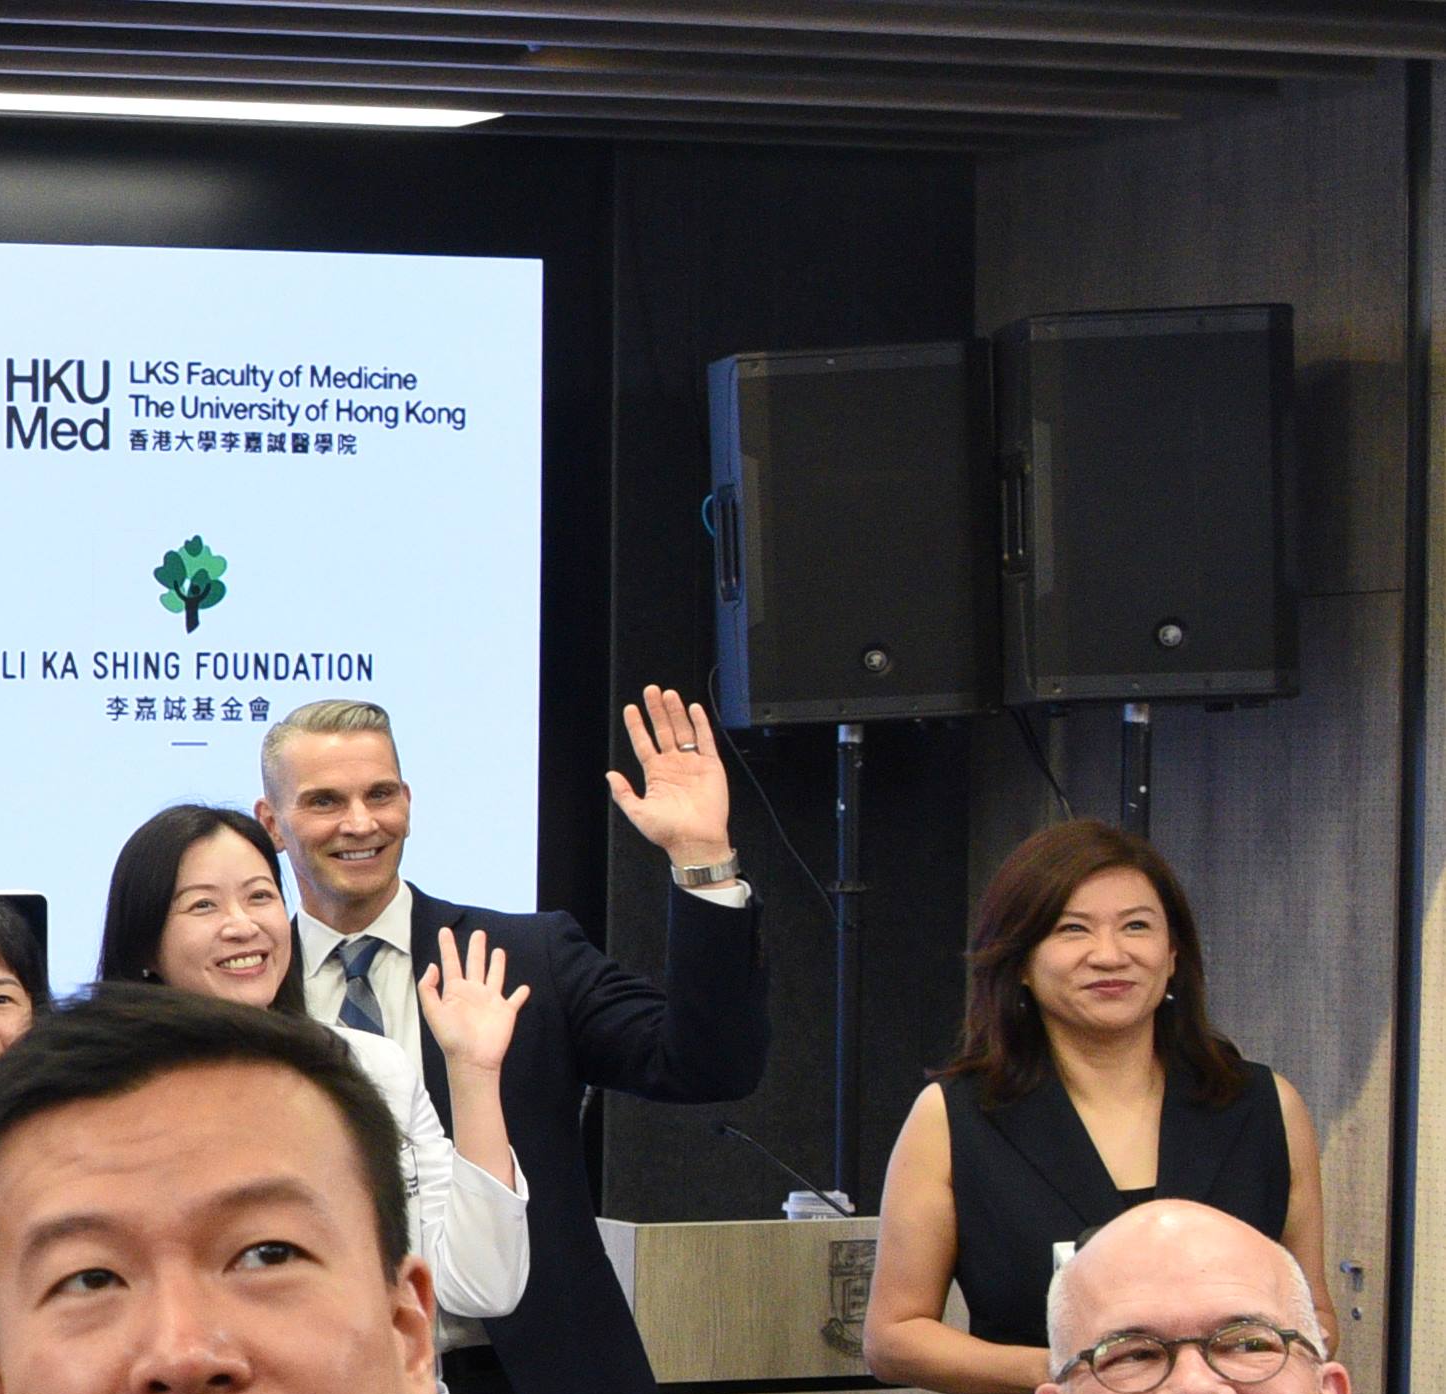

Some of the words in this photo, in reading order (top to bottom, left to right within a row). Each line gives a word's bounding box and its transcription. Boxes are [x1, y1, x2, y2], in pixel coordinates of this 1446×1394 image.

[7, 358, 110, 404] HKU
[129, 361, 180, 385] LKS
[187, 361, 274, 393] Faculty
[279, 365, 303, 388] of
[310, 365, 418, 391] Medicine
[7, 405, 110, 451] Med
[129, 394, 175, 418] The
[181, 395, 300, 427] University
[305, 399, 329, 421] of
[336, 399, 399, 429] Hong
[405, 401, 466, 431] Kong
[129, 429, 358, 455] 香港大學李嘉誠醫學院
[2, 651, 26, 680] LI
[42, 651, 79, 680] KA
[93, 652, 180, 680] SHING
[196, 652, 373, 681] FOUNDATION
[106, 696, 271, 722] 李嘉誠基金會
